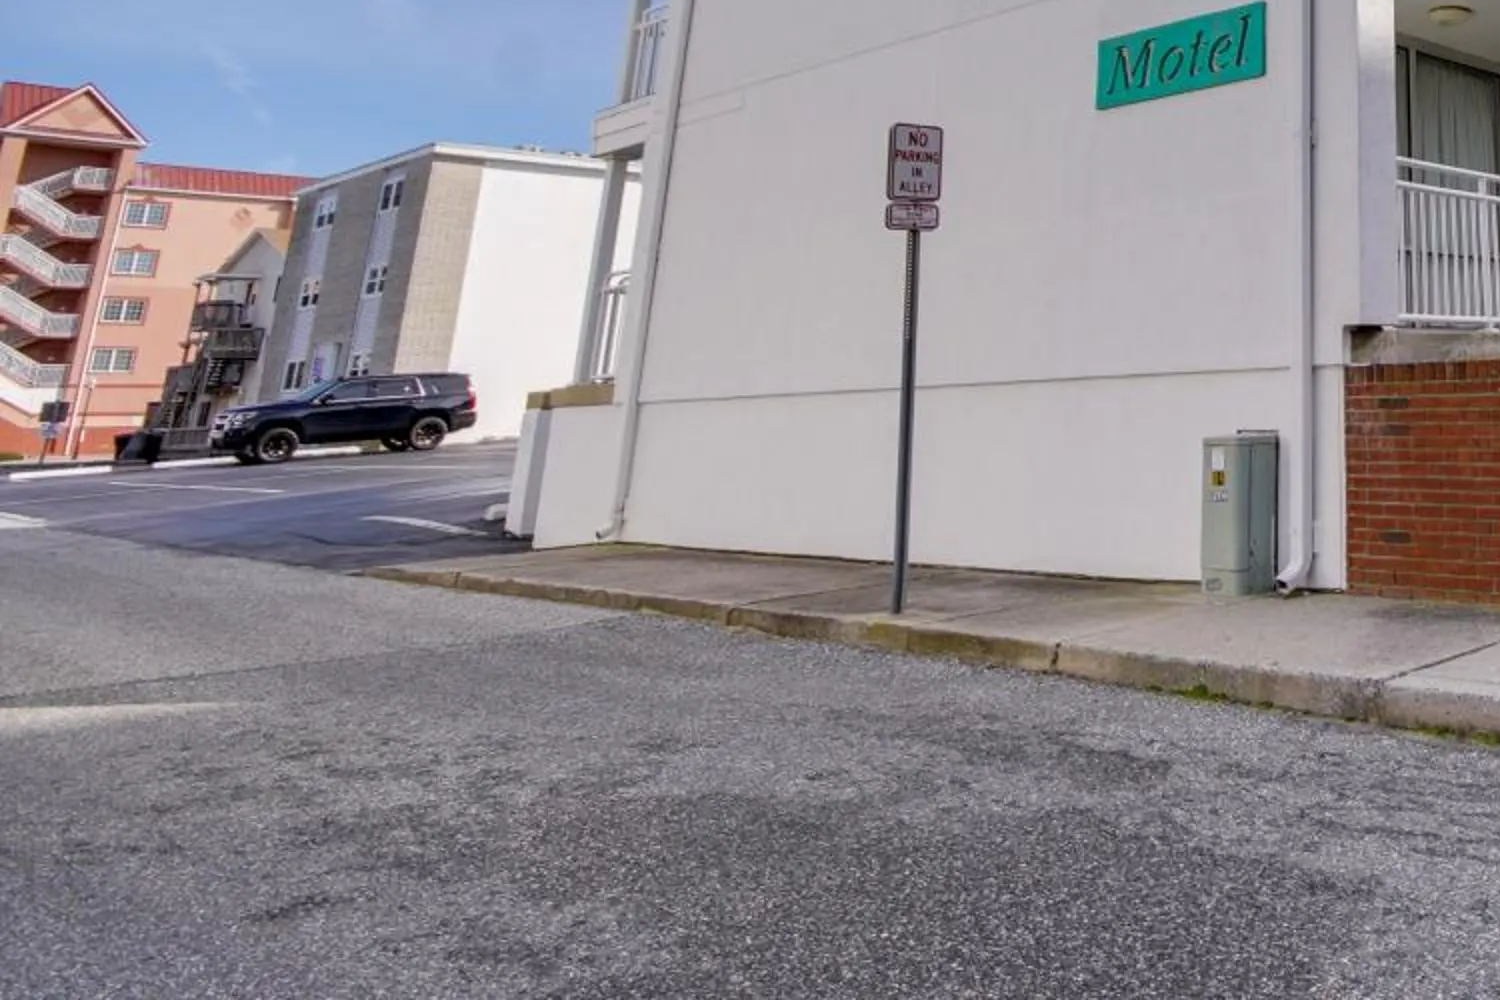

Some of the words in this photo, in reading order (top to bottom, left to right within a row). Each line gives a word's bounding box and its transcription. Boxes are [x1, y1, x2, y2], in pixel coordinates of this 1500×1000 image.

[1106, 14, 1251, 95] Motel
[907, 131, 929, 148] NO
[895, 149, 940, 164] PARKING
[911, 167, 923, 177] IN
[899, 181, 932, 194] ALLEY
